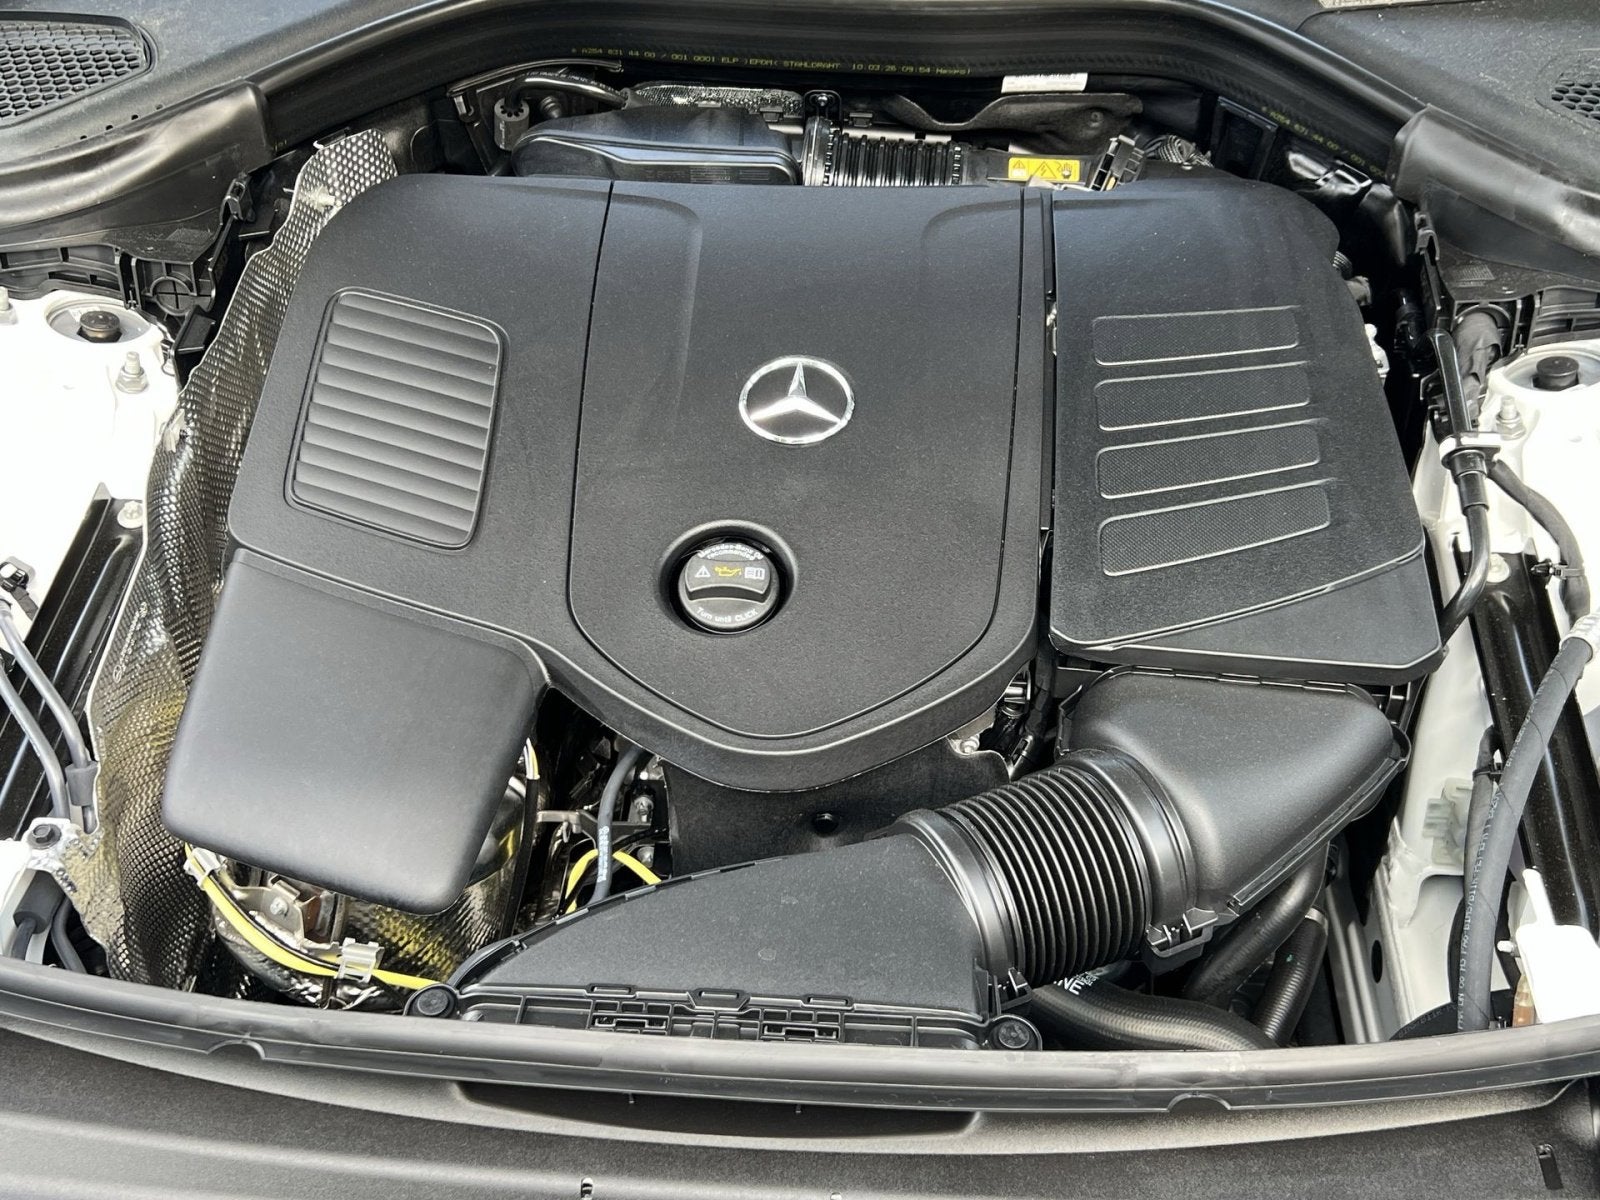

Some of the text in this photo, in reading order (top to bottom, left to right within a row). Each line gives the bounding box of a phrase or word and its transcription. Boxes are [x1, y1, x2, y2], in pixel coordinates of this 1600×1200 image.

[696, 606, 759, 623] Turn until CLICK
